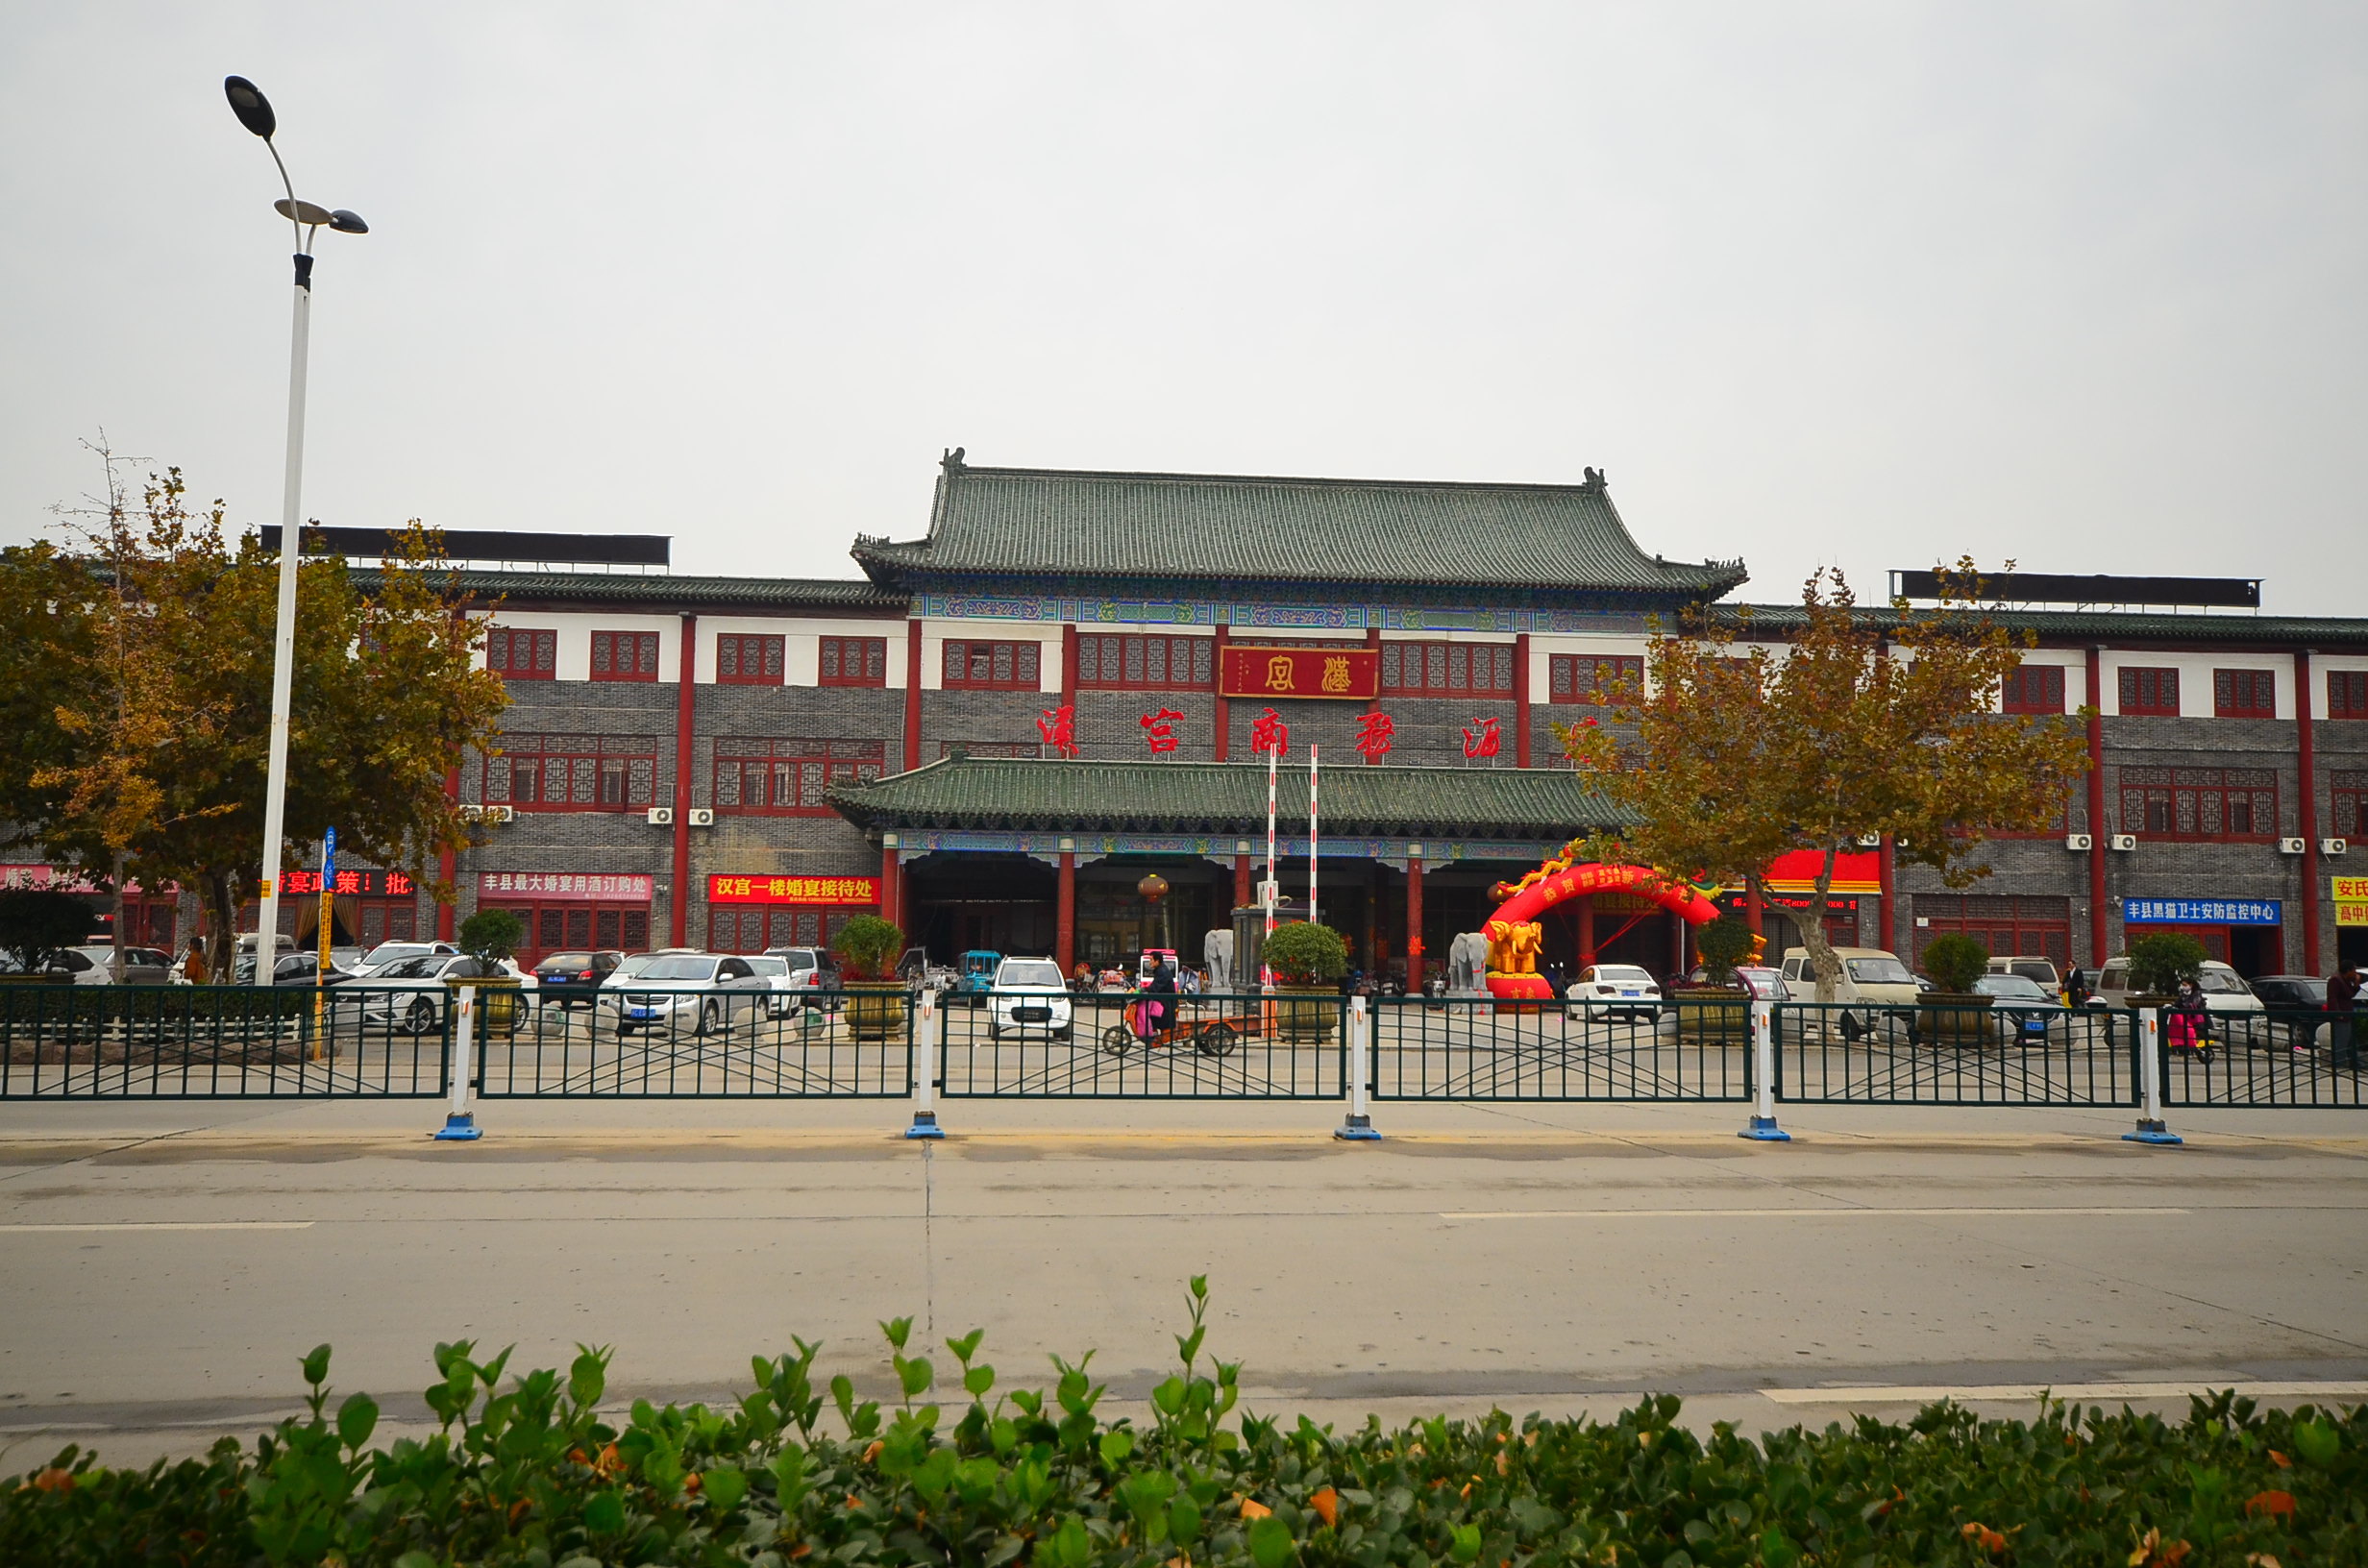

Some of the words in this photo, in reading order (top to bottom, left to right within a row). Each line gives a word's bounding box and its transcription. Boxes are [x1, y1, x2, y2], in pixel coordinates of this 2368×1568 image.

[484, 873, 646, 893] 丰县最大婚宴用酒订购处
[717, 878, 872, 897] 汉宫一楼婚宴接待处
[2129, 902, 2274, 920] 丰县黑猫卫士安防监控中心
